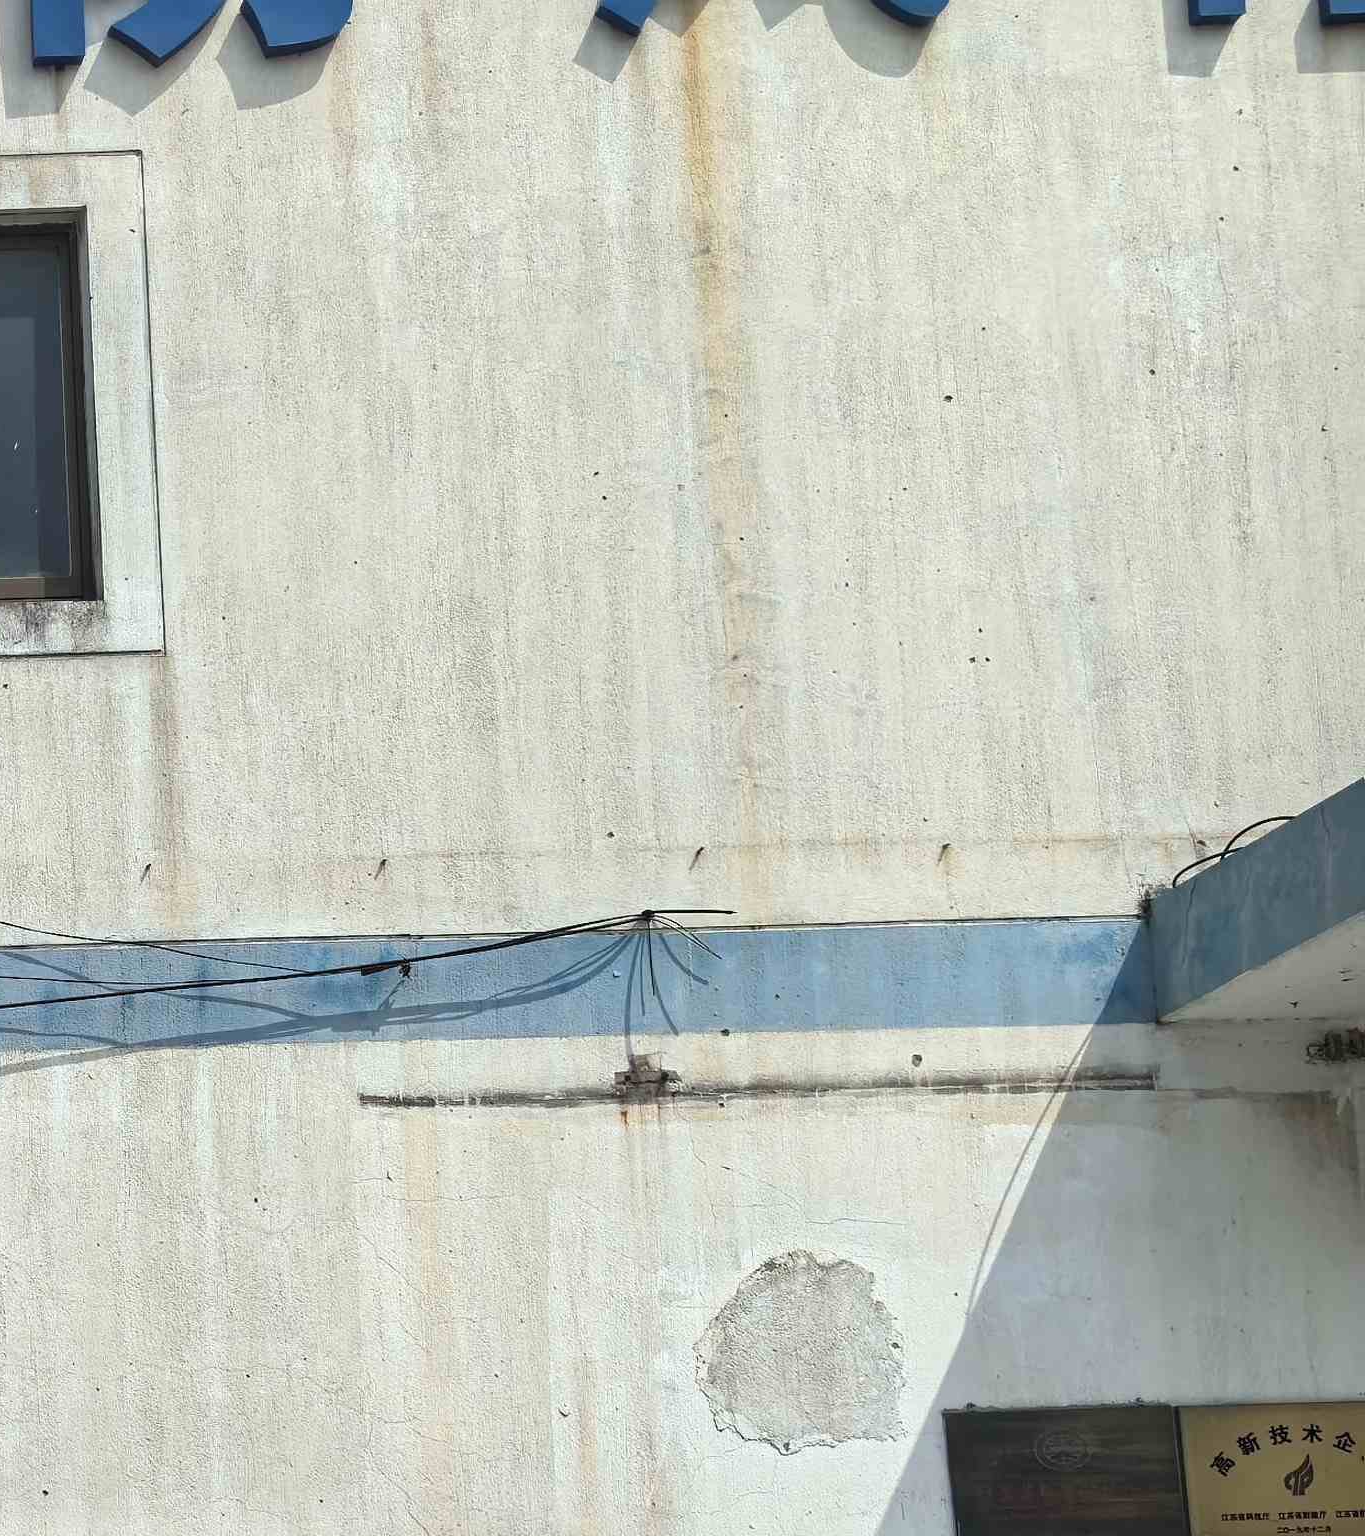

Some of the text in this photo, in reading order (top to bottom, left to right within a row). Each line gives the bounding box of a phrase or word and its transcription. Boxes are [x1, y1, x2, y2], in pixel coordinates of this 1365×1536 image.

[1210, 1423, 1365, 1477] 高新技术企
